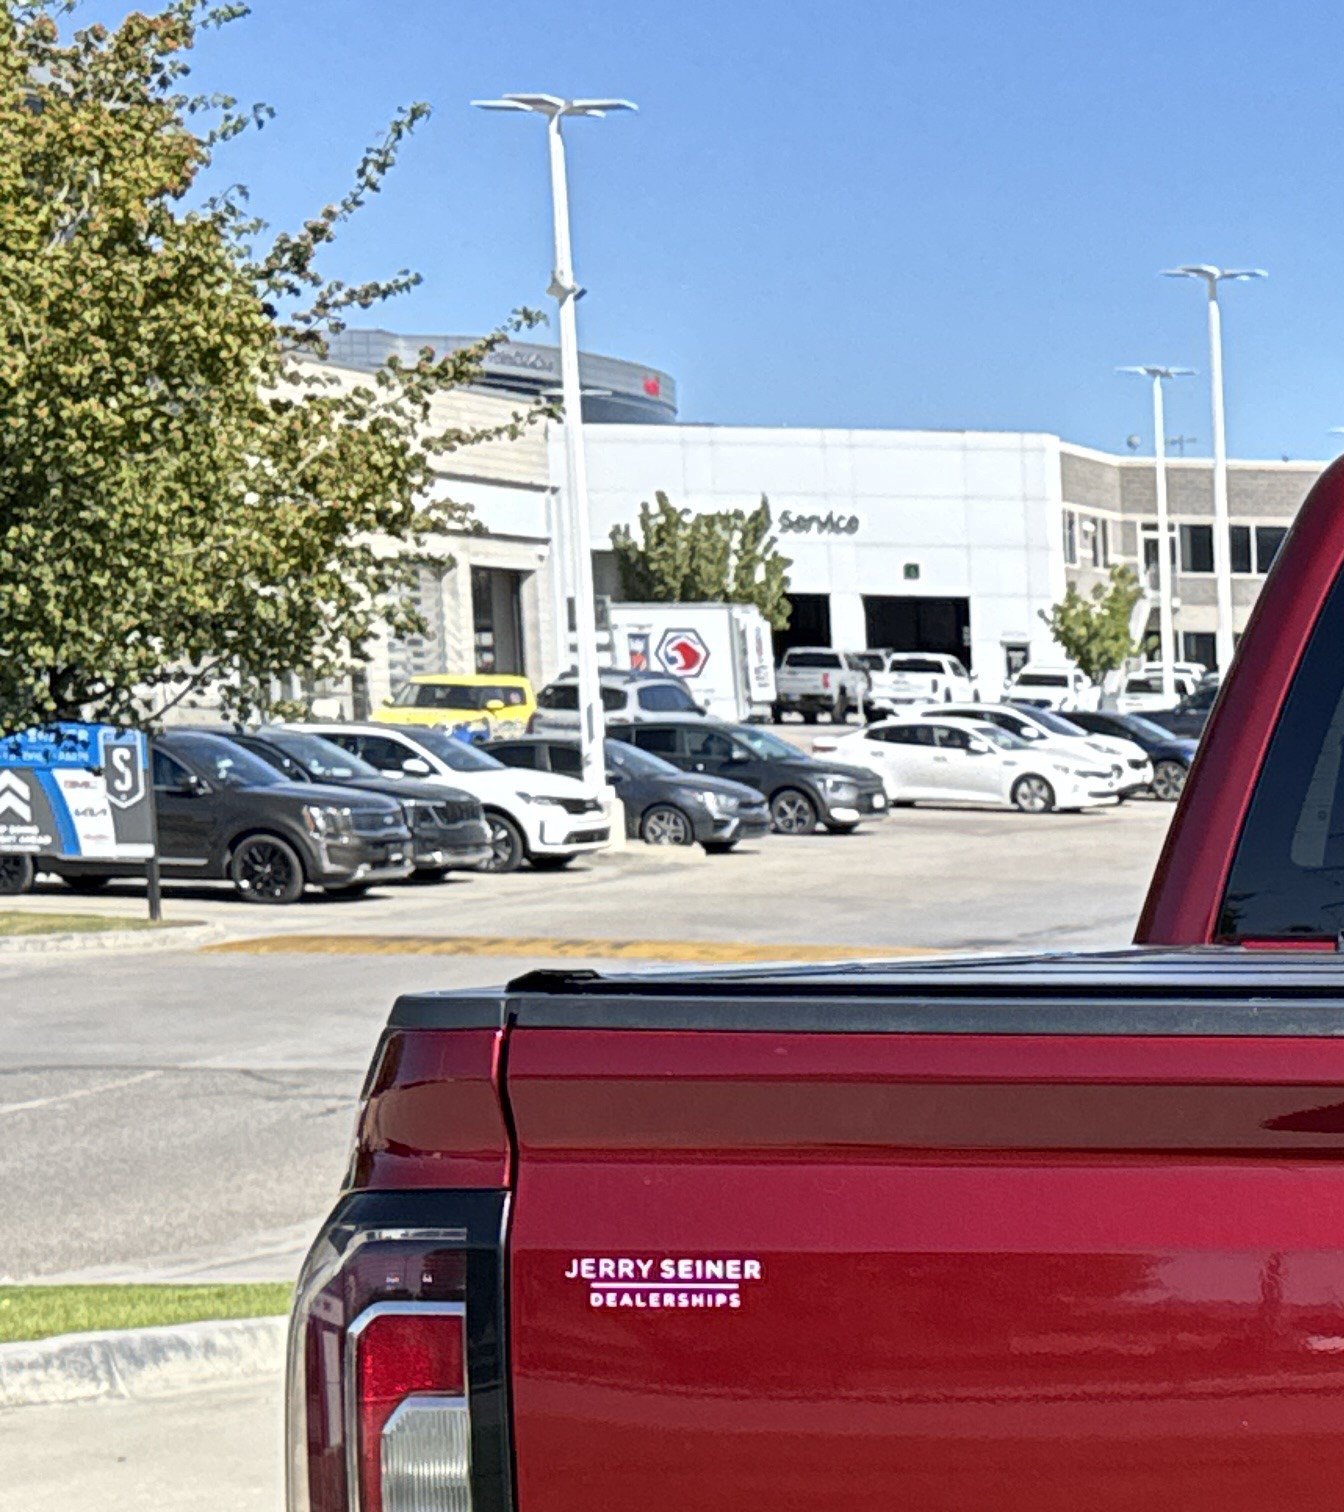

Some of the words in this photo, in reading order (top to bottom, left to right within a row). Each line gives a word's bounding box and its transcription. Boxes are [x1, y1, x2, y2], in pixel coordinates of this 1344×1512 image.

[778, 510, 860, 535] Service
[564, 1258, 654, 1279] JERRY
[659, 1258, 762, 1280] SEINER
[589, 1292, 742, 1308] DEALERSHIPS
